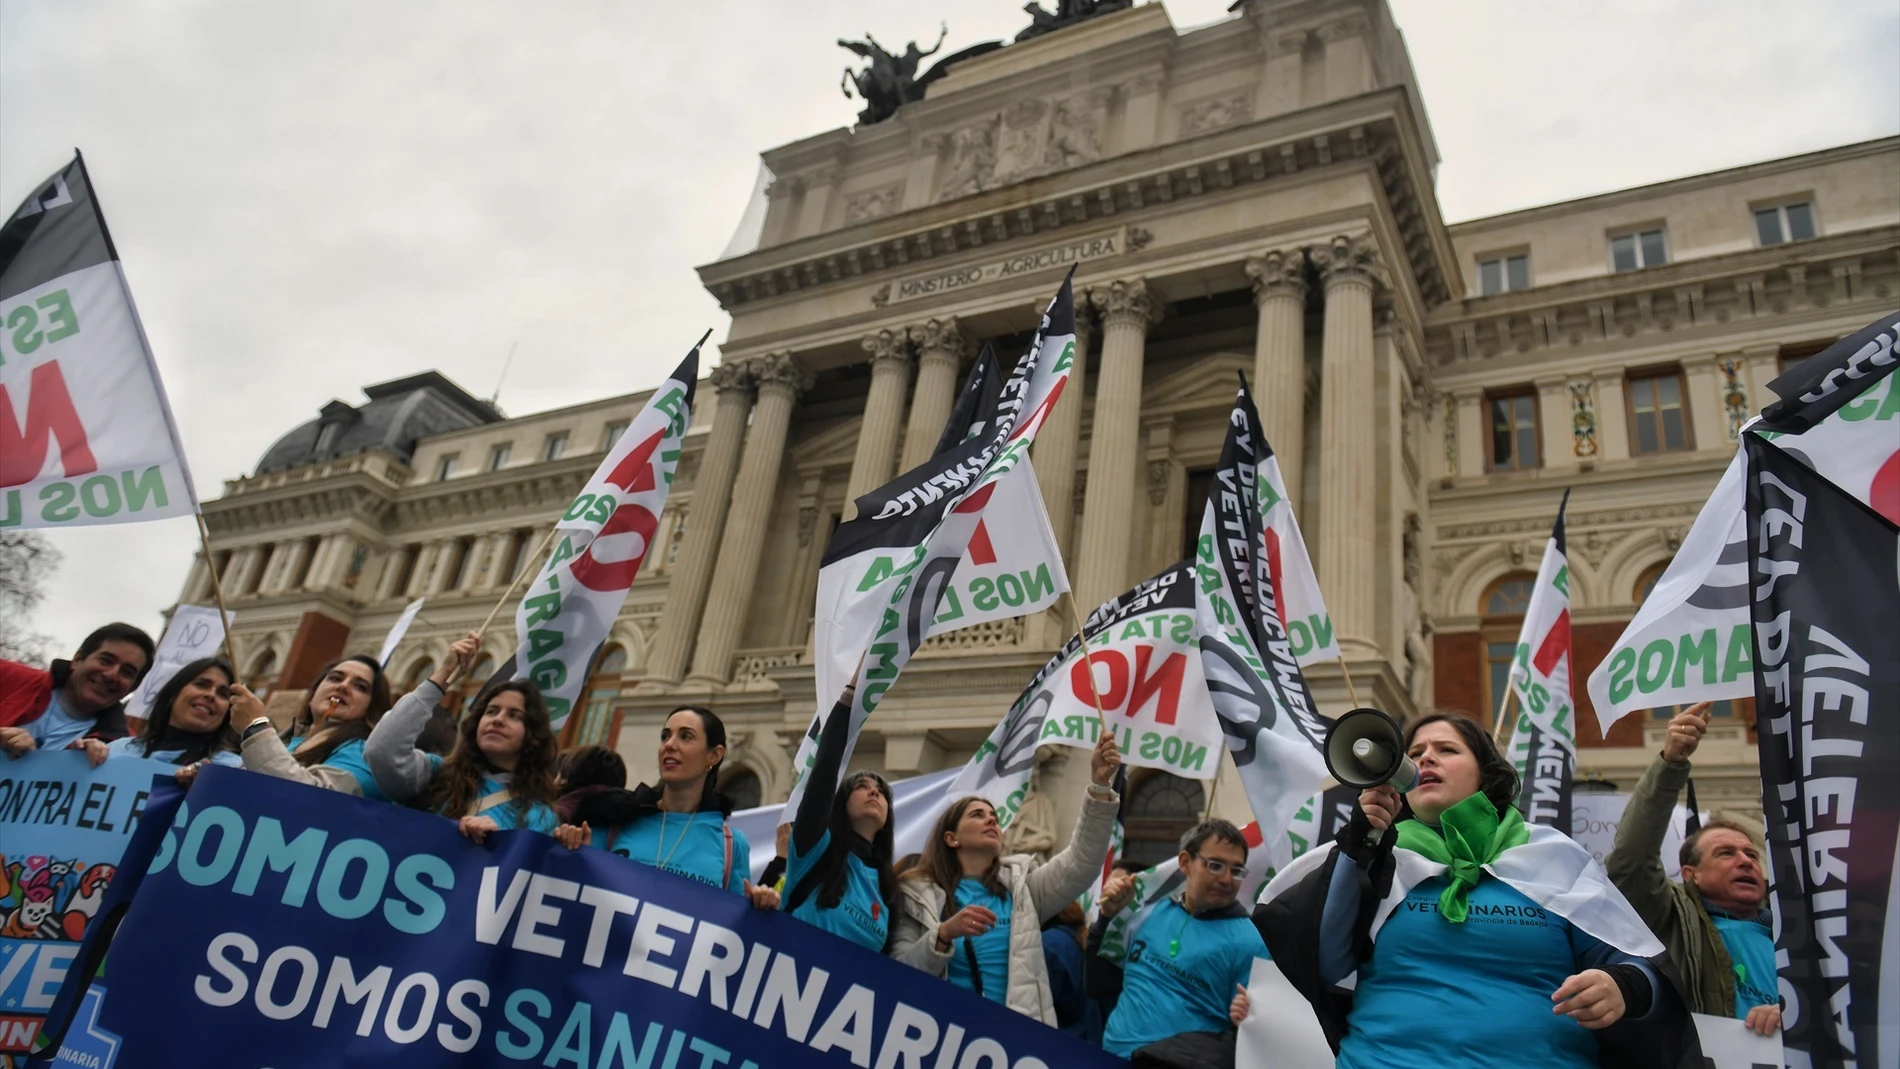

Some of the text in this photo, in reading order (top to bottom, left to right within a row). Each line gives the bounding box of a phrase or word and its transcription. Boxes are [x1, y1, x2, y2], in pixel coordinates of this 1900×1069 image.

[900, 269, 982, 298] MINISTERIO
[1000, 239, 1116, 277] AGRICULTURA
[76, 782, 117, 833] EL
[194, 931, 491, 1054] SOMOS
